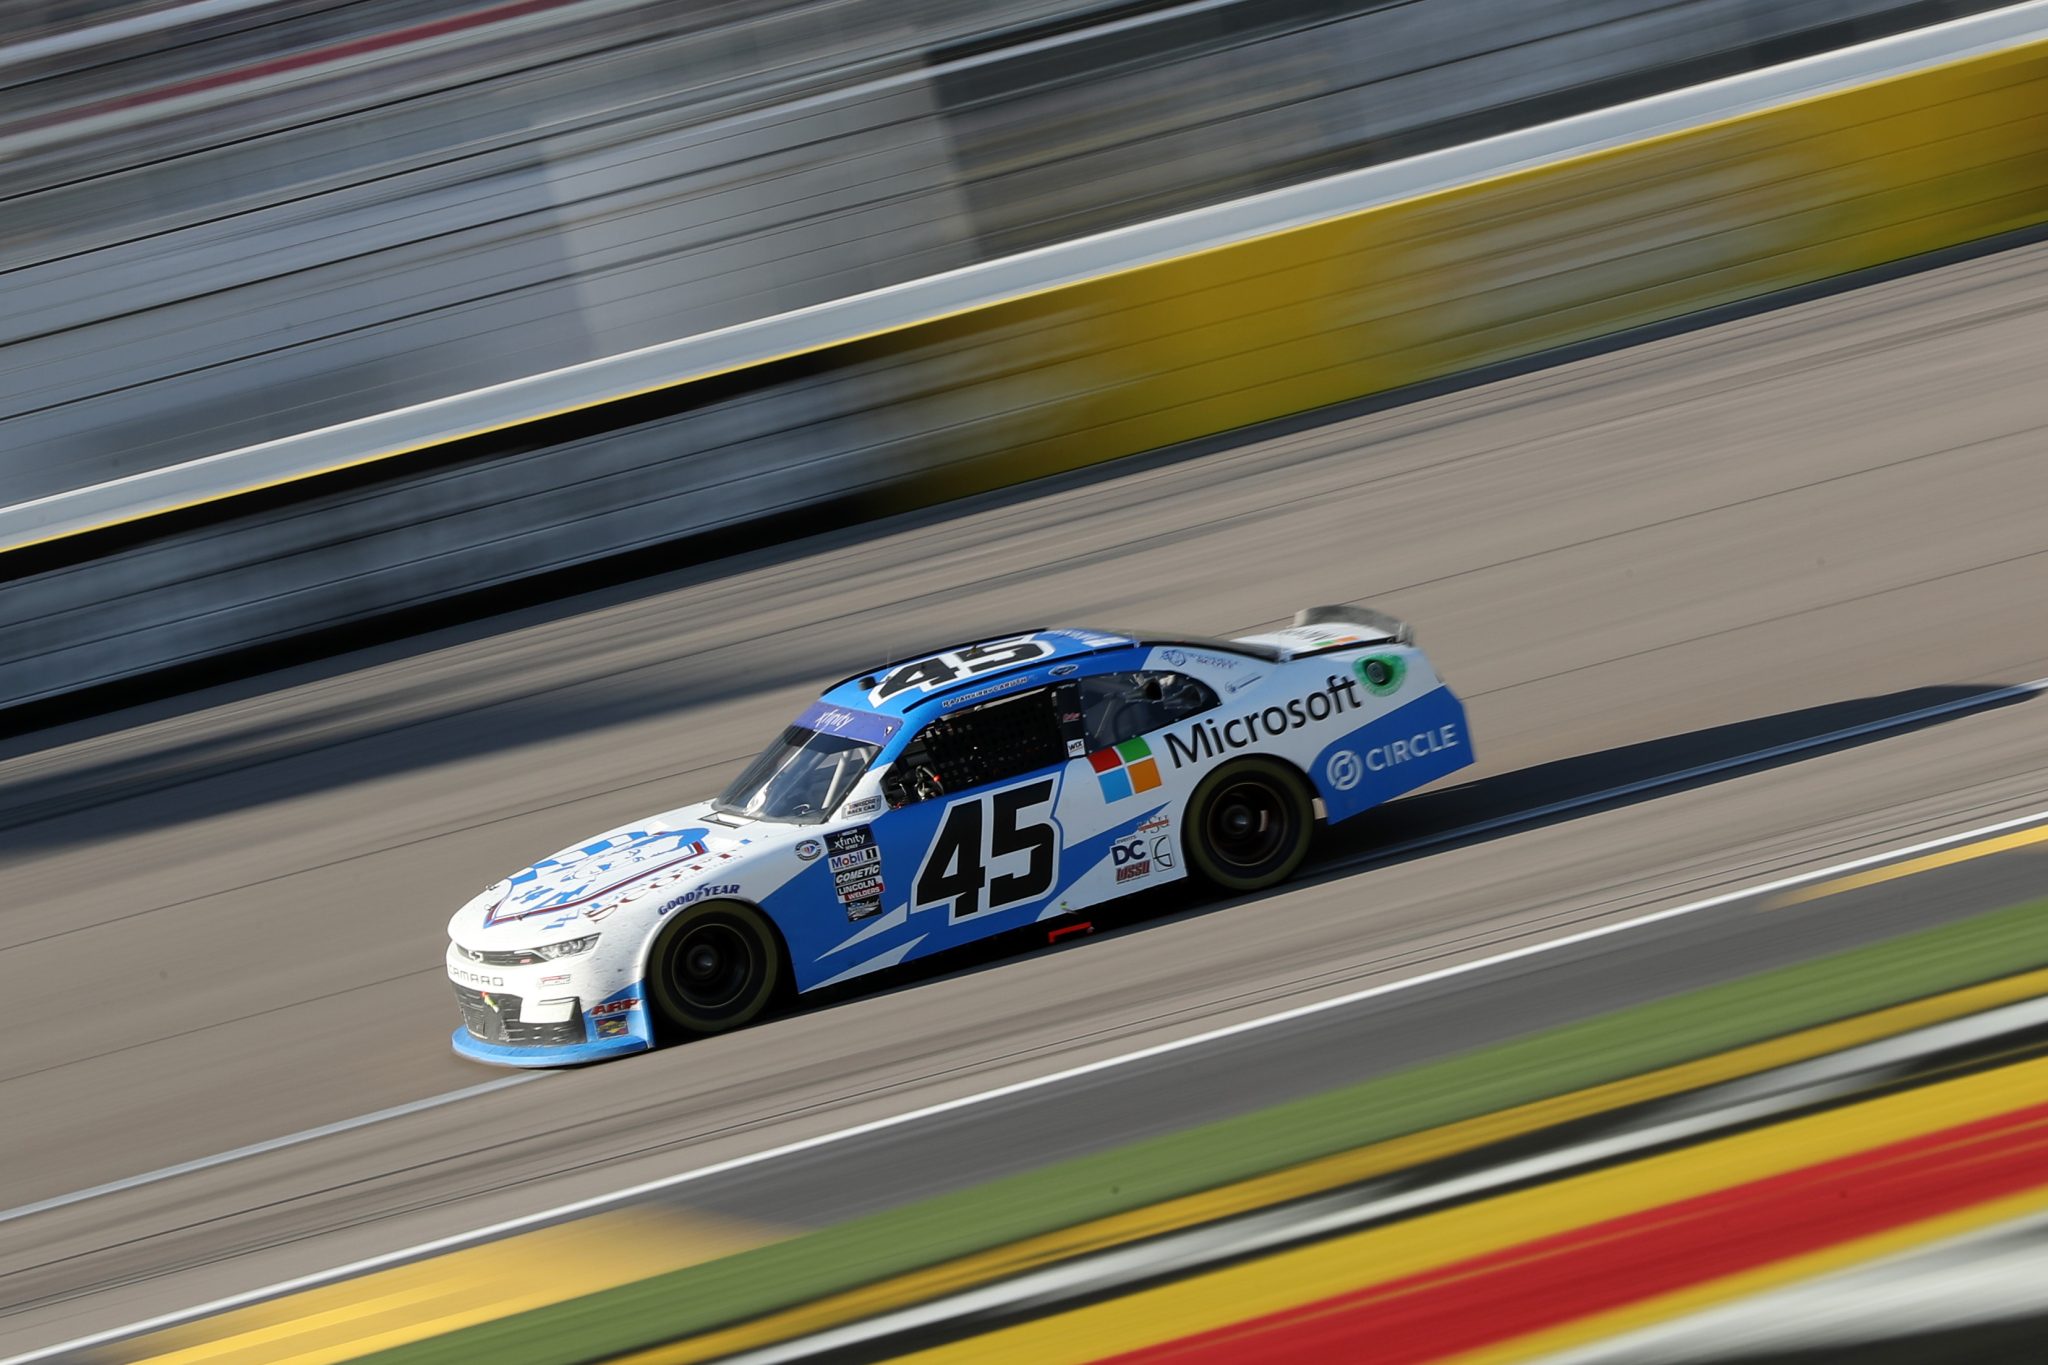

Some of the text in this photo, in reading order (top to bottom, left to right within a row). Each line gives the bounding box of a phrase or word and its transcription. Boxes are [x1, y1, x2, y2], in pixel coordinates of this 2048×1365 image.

[876, 636, 1046, 700] 45
[815, 709, 854, 732] xfinity
[1163, 674, 1362, 769] Microsoft
[1069, 741, 1083, 750] WIX
[1366, 724, 1460, 771] CIRCLE
[847, 804, 876, 815] RACE CAR
[834, 834, 866, 850] xfinity
[916, 778, 1055, 919] 45
[831, 851, 864, 869] Mobil
[1111, 840, 1146, 866] DC
[835, 864, 880, 883] COMETIC
[838, 879, 875, 895] LINCOLN
[847, 886, 881, 900] WELDERS
[657, 883, 741, 916] GOODYEAR
[449, 964, 504, 987] CAMARO
[591, 999, 638, 1015] ARP
